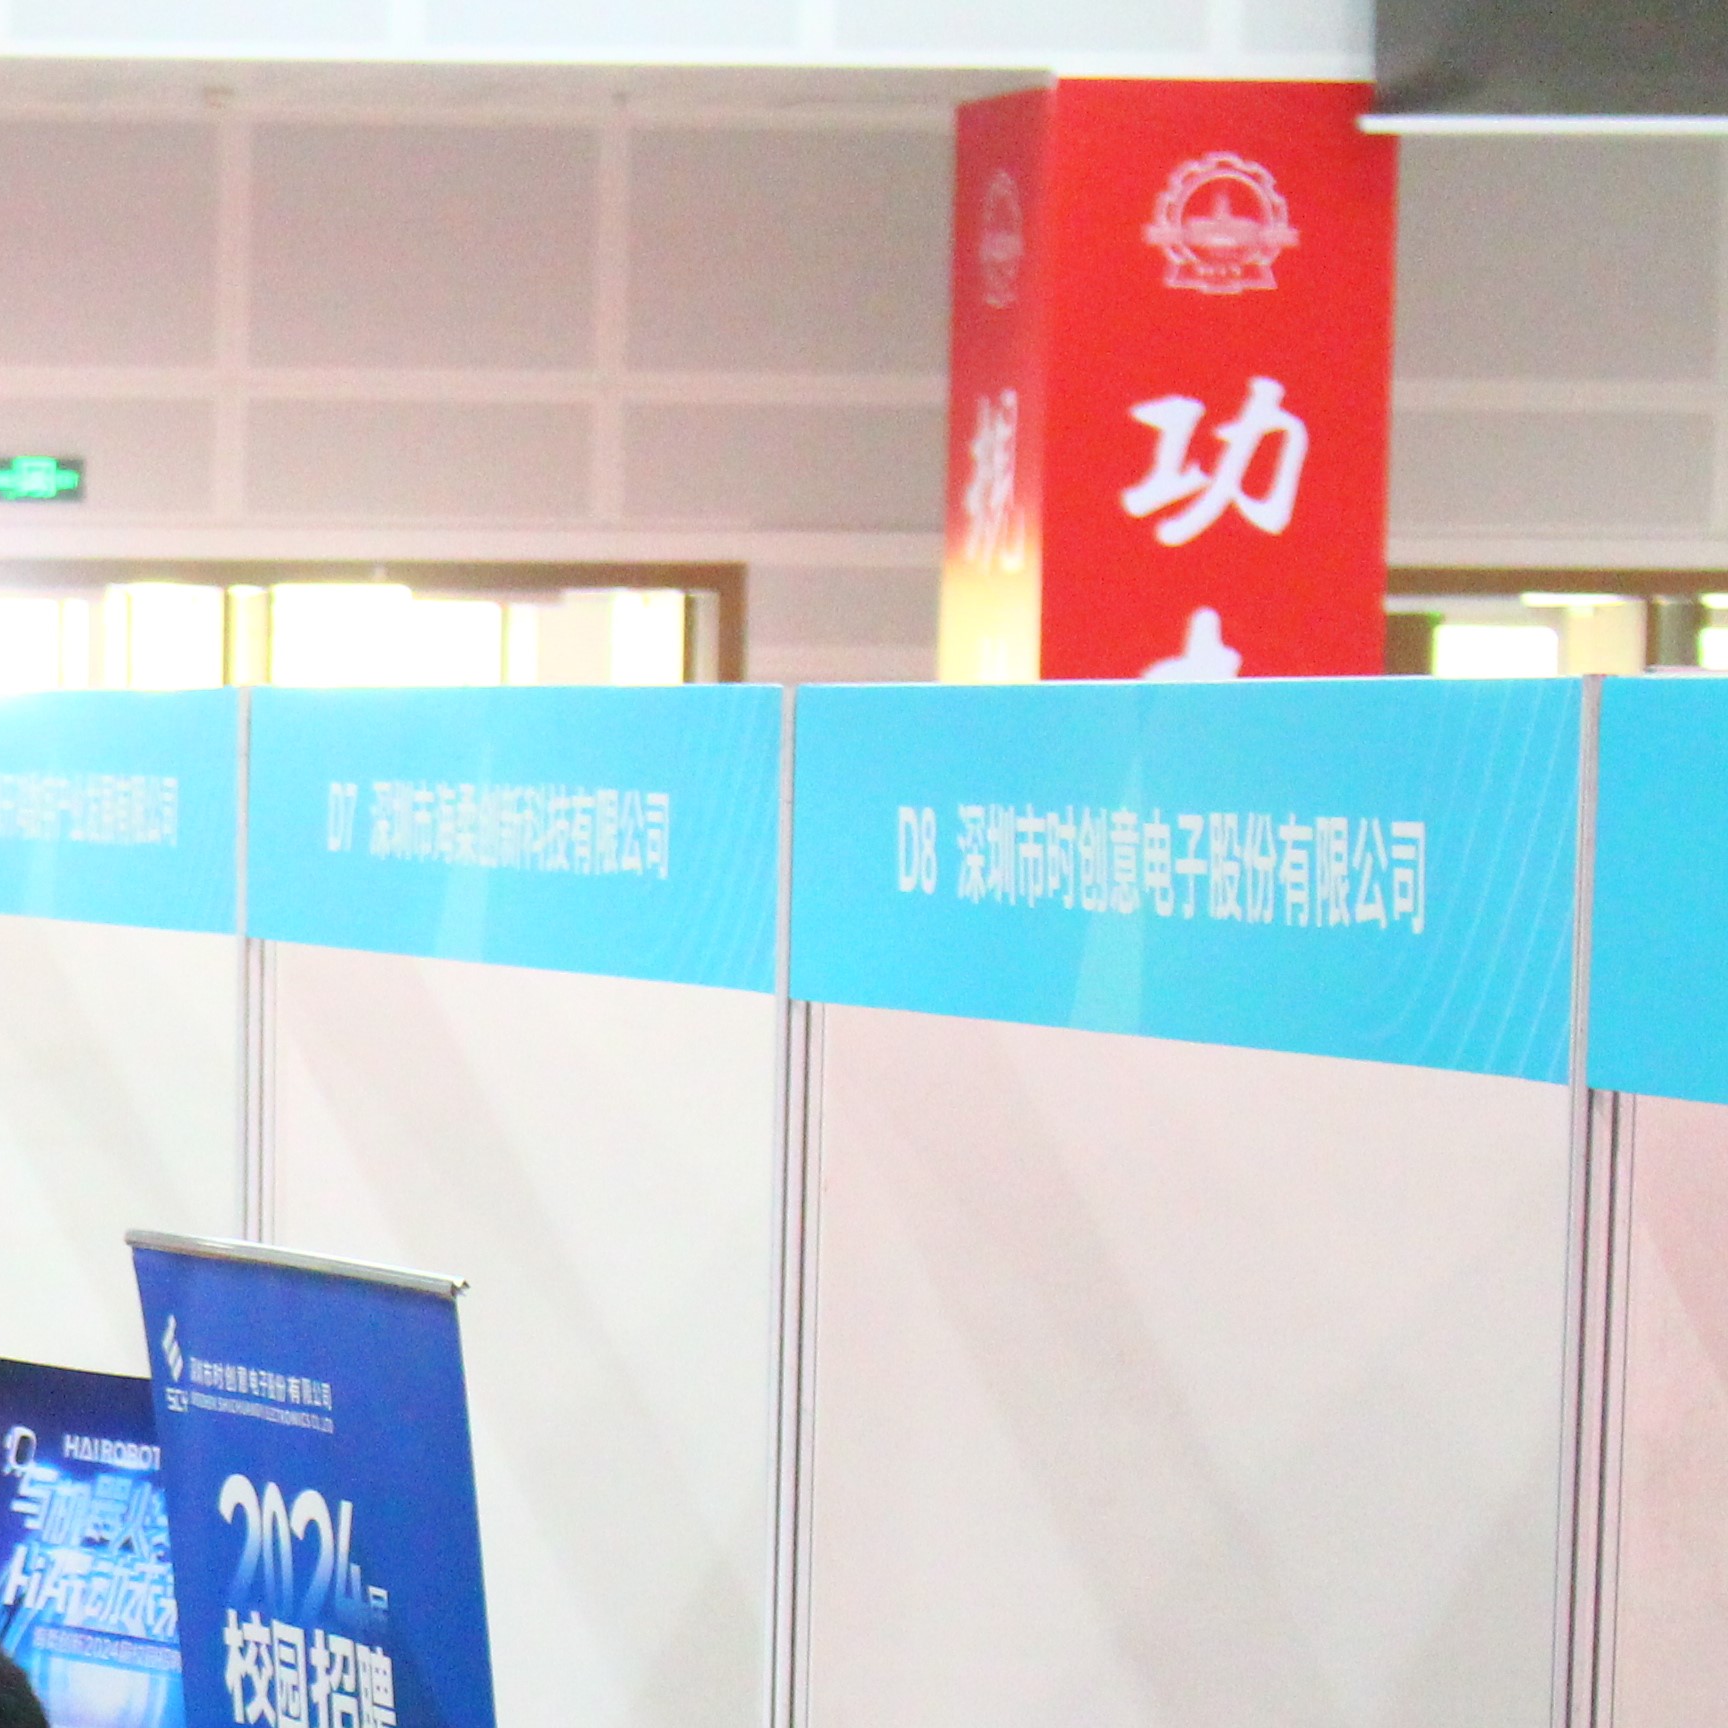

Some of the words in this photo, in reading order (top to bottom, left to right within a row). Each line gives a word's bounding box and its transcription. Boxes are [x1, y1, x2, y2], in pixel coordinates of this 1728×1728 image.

[328, 782, 357, 851] D7
[897, 806, 938, 895] D8
[956, 803, 1426, 934] 深圳市时创意电子股份有限公司
